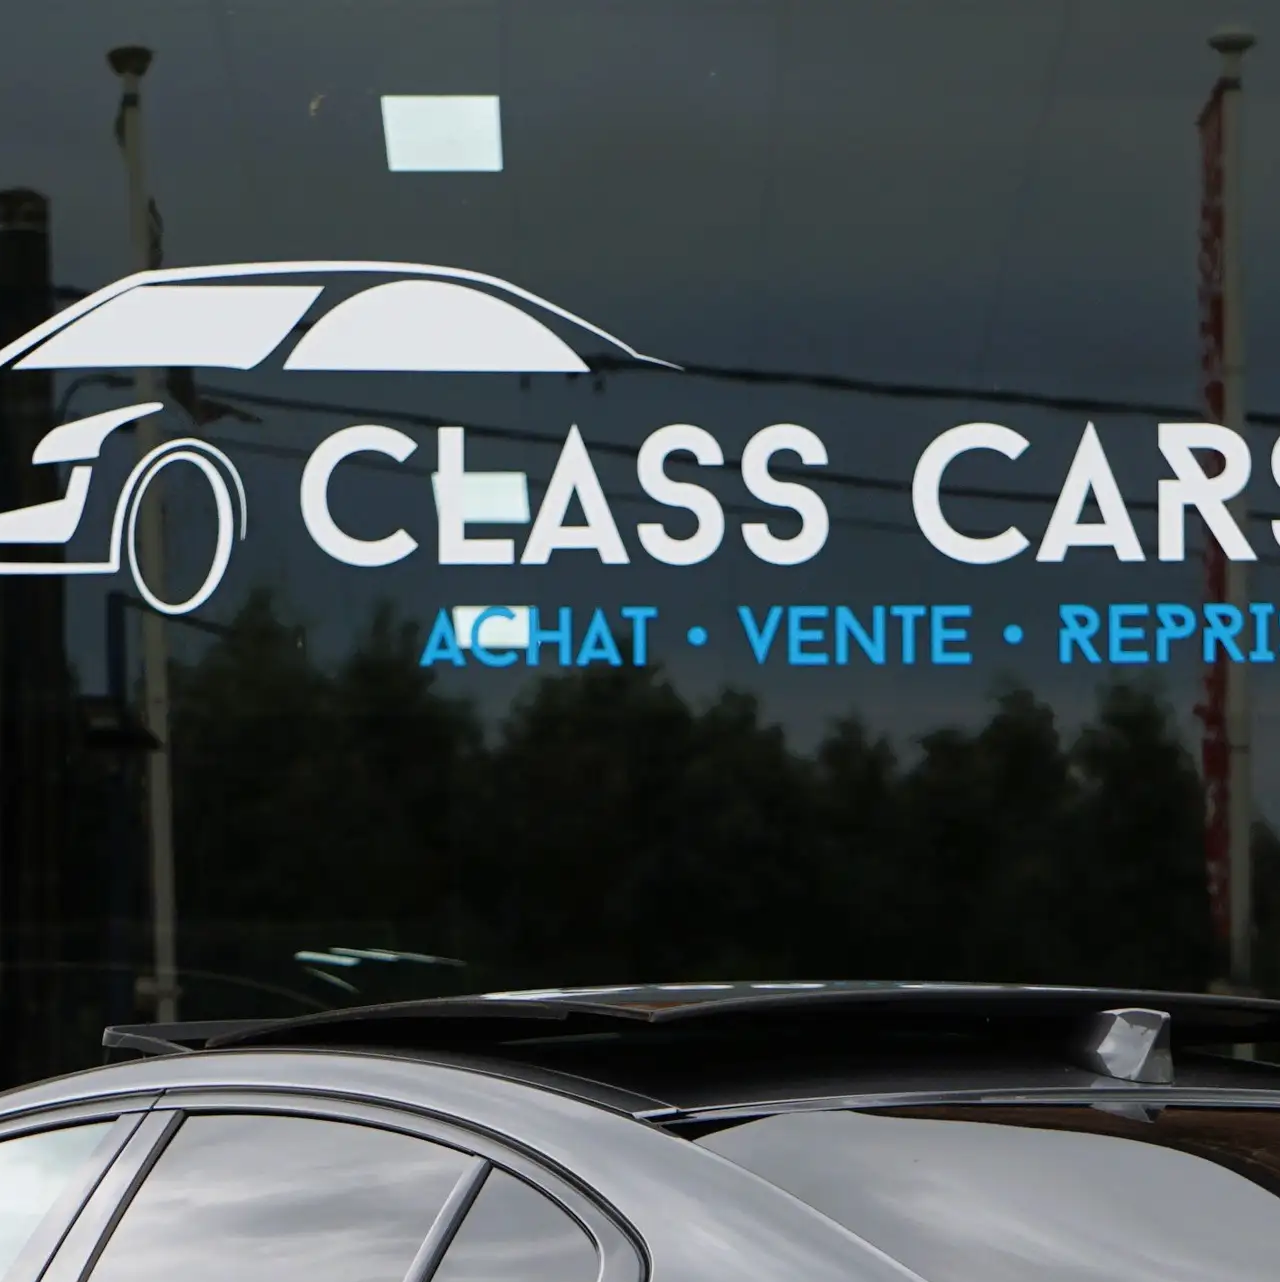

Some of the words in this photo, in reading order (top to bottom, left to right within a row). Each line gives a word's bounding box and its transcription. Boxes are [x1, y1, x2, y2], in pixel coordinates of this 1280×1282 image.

[300, 423, 829, 567] CLASS
[419, 605, 659, 668] ACHAT
[738, 604, 973, 667] VENTE
